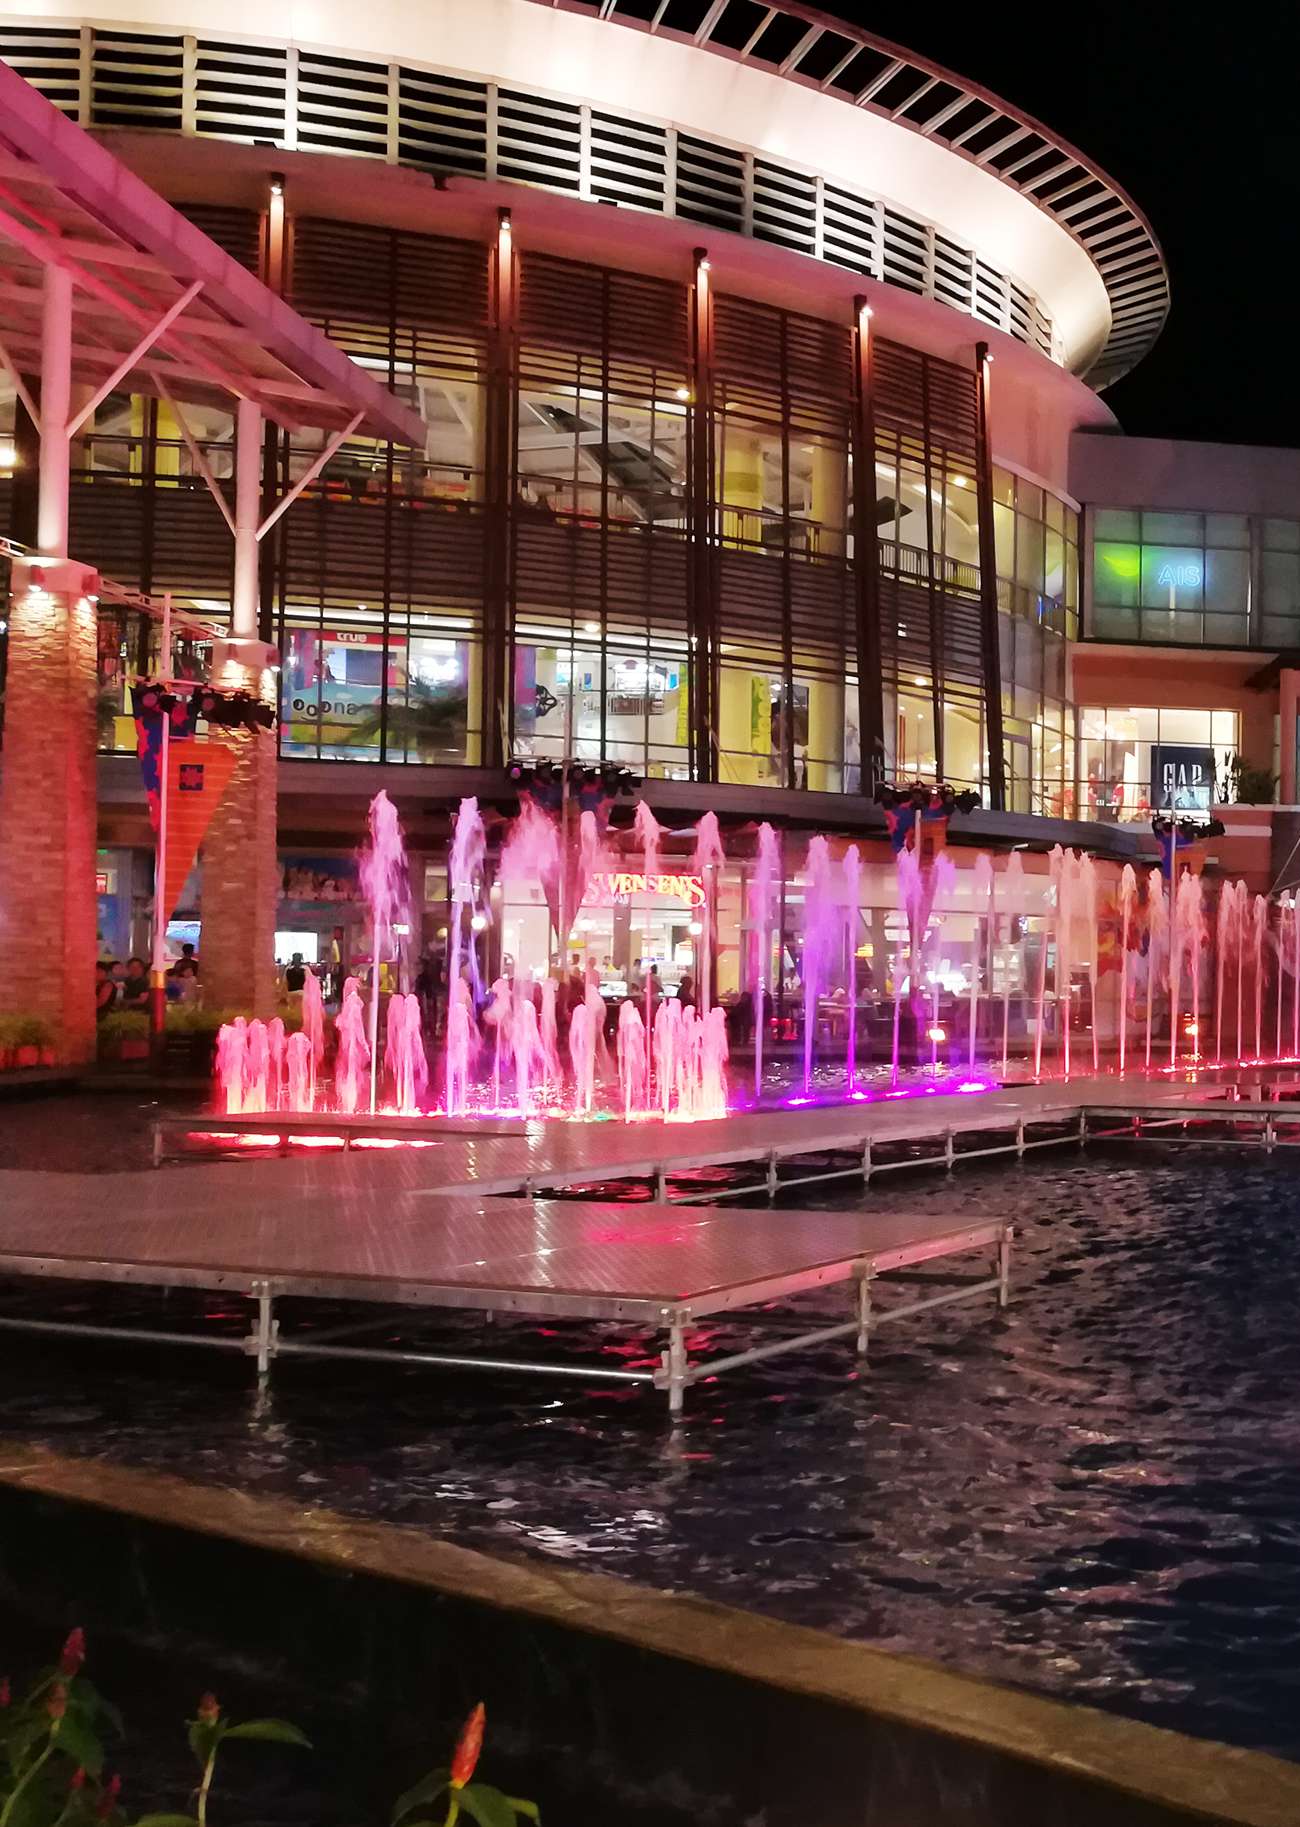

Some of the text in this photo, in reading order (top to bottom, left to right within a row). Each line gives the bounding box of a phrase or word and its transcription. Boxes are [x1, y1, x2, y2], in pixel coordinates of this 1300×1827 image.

[1158, 564, 1201, 586] AIS
[336, 632, 367, 643] true
[1163, 763, 1203, 793] GAP
